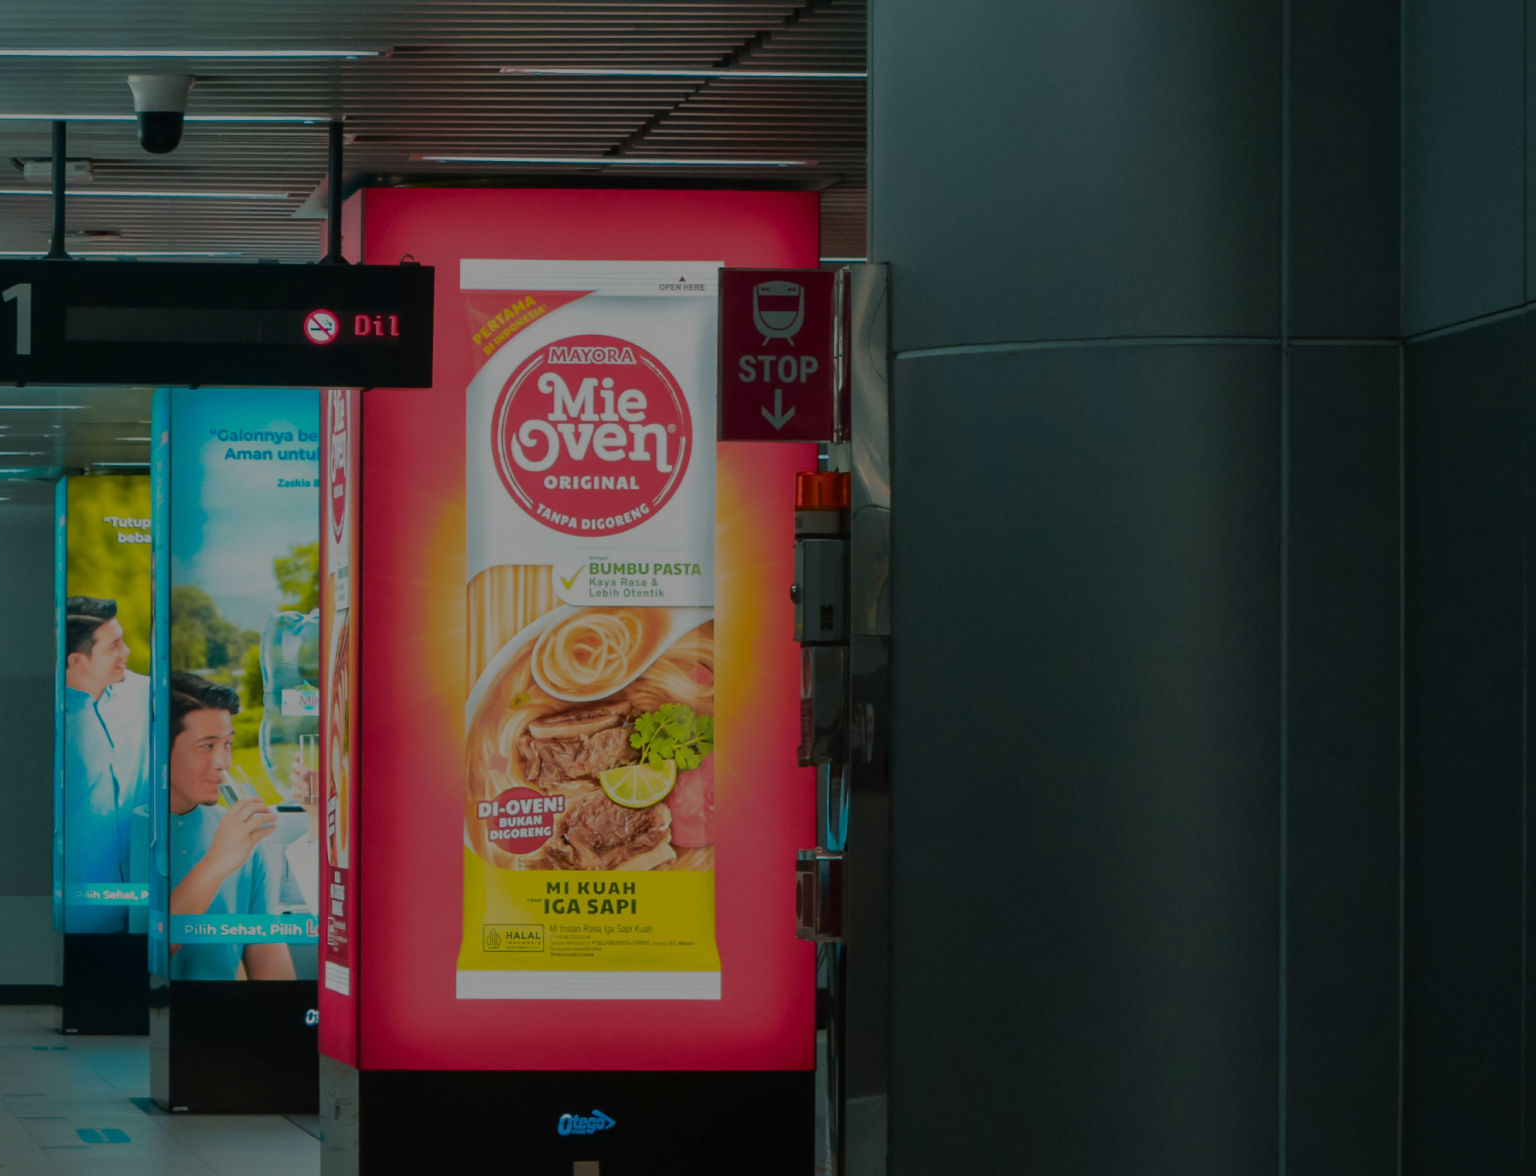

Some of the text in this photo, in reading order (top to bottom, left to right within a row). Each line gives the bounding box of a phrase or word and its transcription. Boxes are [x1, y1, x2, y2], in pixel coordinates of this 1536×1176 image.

[659, 283, 705, 291] OPEN HERE
[2, 282, 32, 355] 1
[354, 313, 400, 337] Dil
[472, 295, 537, 346] PERTAMA
[482, 342, 497, 356] DI
[547, 346, 637, 365] MAYORA
[737, 354, 820, 385] STOP
[537, 371, 648, 423] Mie
[510, 418, 673, 474] Oven
[224, 448, 273, 461] Aman
[277, 478, 311, 488] Zaskia
[543, 475, 640, 490] ORIGINAL
[536, 502, 651, 530] TANPA DIGORENG
[589, 562, 703, 576] BUMBU PASTA
[589, 577, 659, 589] Kaya Rasa &
[589, 587, 665, 598] Lebih Otentik
[477, 795, 565, 819] DI-OVEN!
[498, 814, 544, 829] BUKAN
[489, 825, 553, 841] DIGORENG
[546, 881, 637, 895] MI KUAH
[543, 898, 637, 915] IGA SAPI
[184, 923, 217, 936] Pilih
[219, 923, 267, 938] Sehat,
[269, 923, 303, 936] Pilih
[505, 930, 542, 940] HALAL
